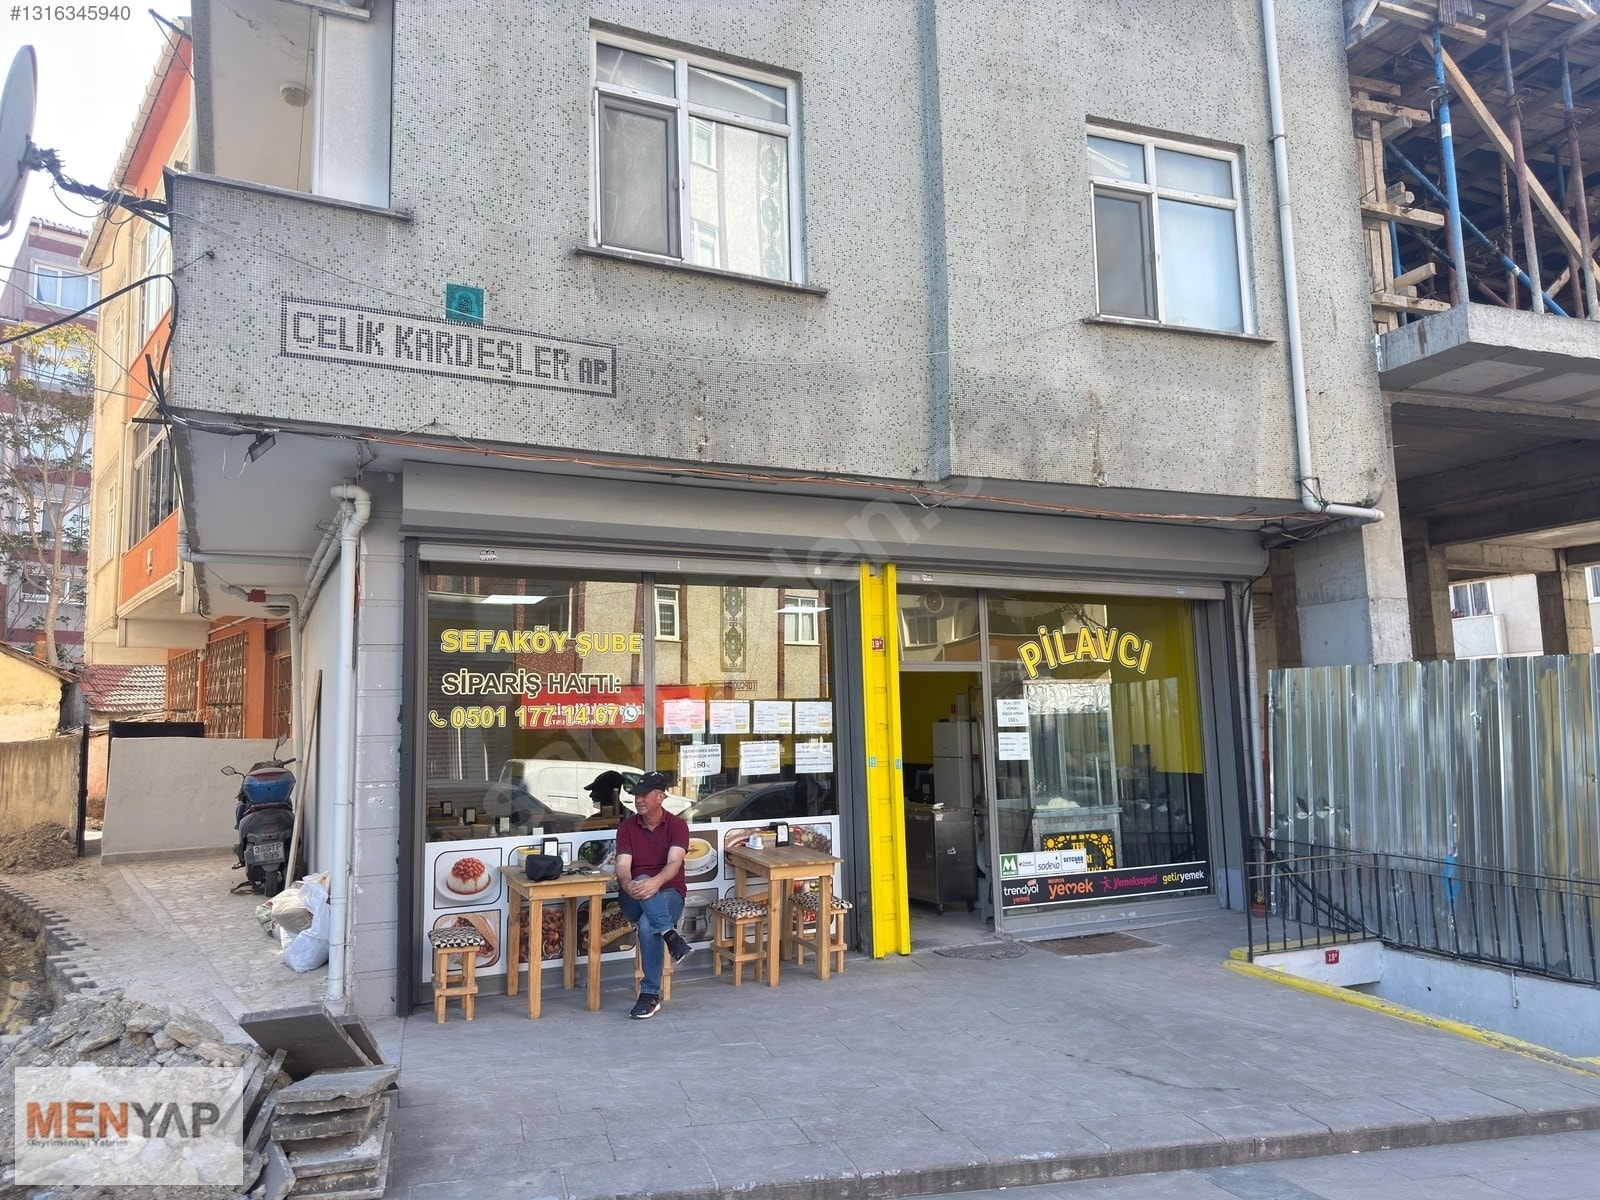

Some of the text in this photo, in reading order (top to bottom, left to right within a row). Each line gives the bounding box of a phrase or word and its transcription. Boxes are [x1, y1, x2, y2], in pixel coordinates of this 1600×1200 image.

[293, 311, 385, 357] ÇELİK
[395, 324, 569, 381] KARDEŞLER
[441, 626, 644, 659] SEFAKÖY ŞUBE
[1018, 624, 1153, 680] PİLAVCI
[441, 668, 622, 698] SİPARİŞ HATTI:
[450, 705, 507, 729] 0501
[515, 704, 555, 727] 177
[564, 704, 589, 726] 14
[593, 704, 621, 725] 67
[1003, 884, 1039, 897] trendyol
[1048, 878, 1094, 899] yemek
[1162, 869, 1204, 885] getiryemek
